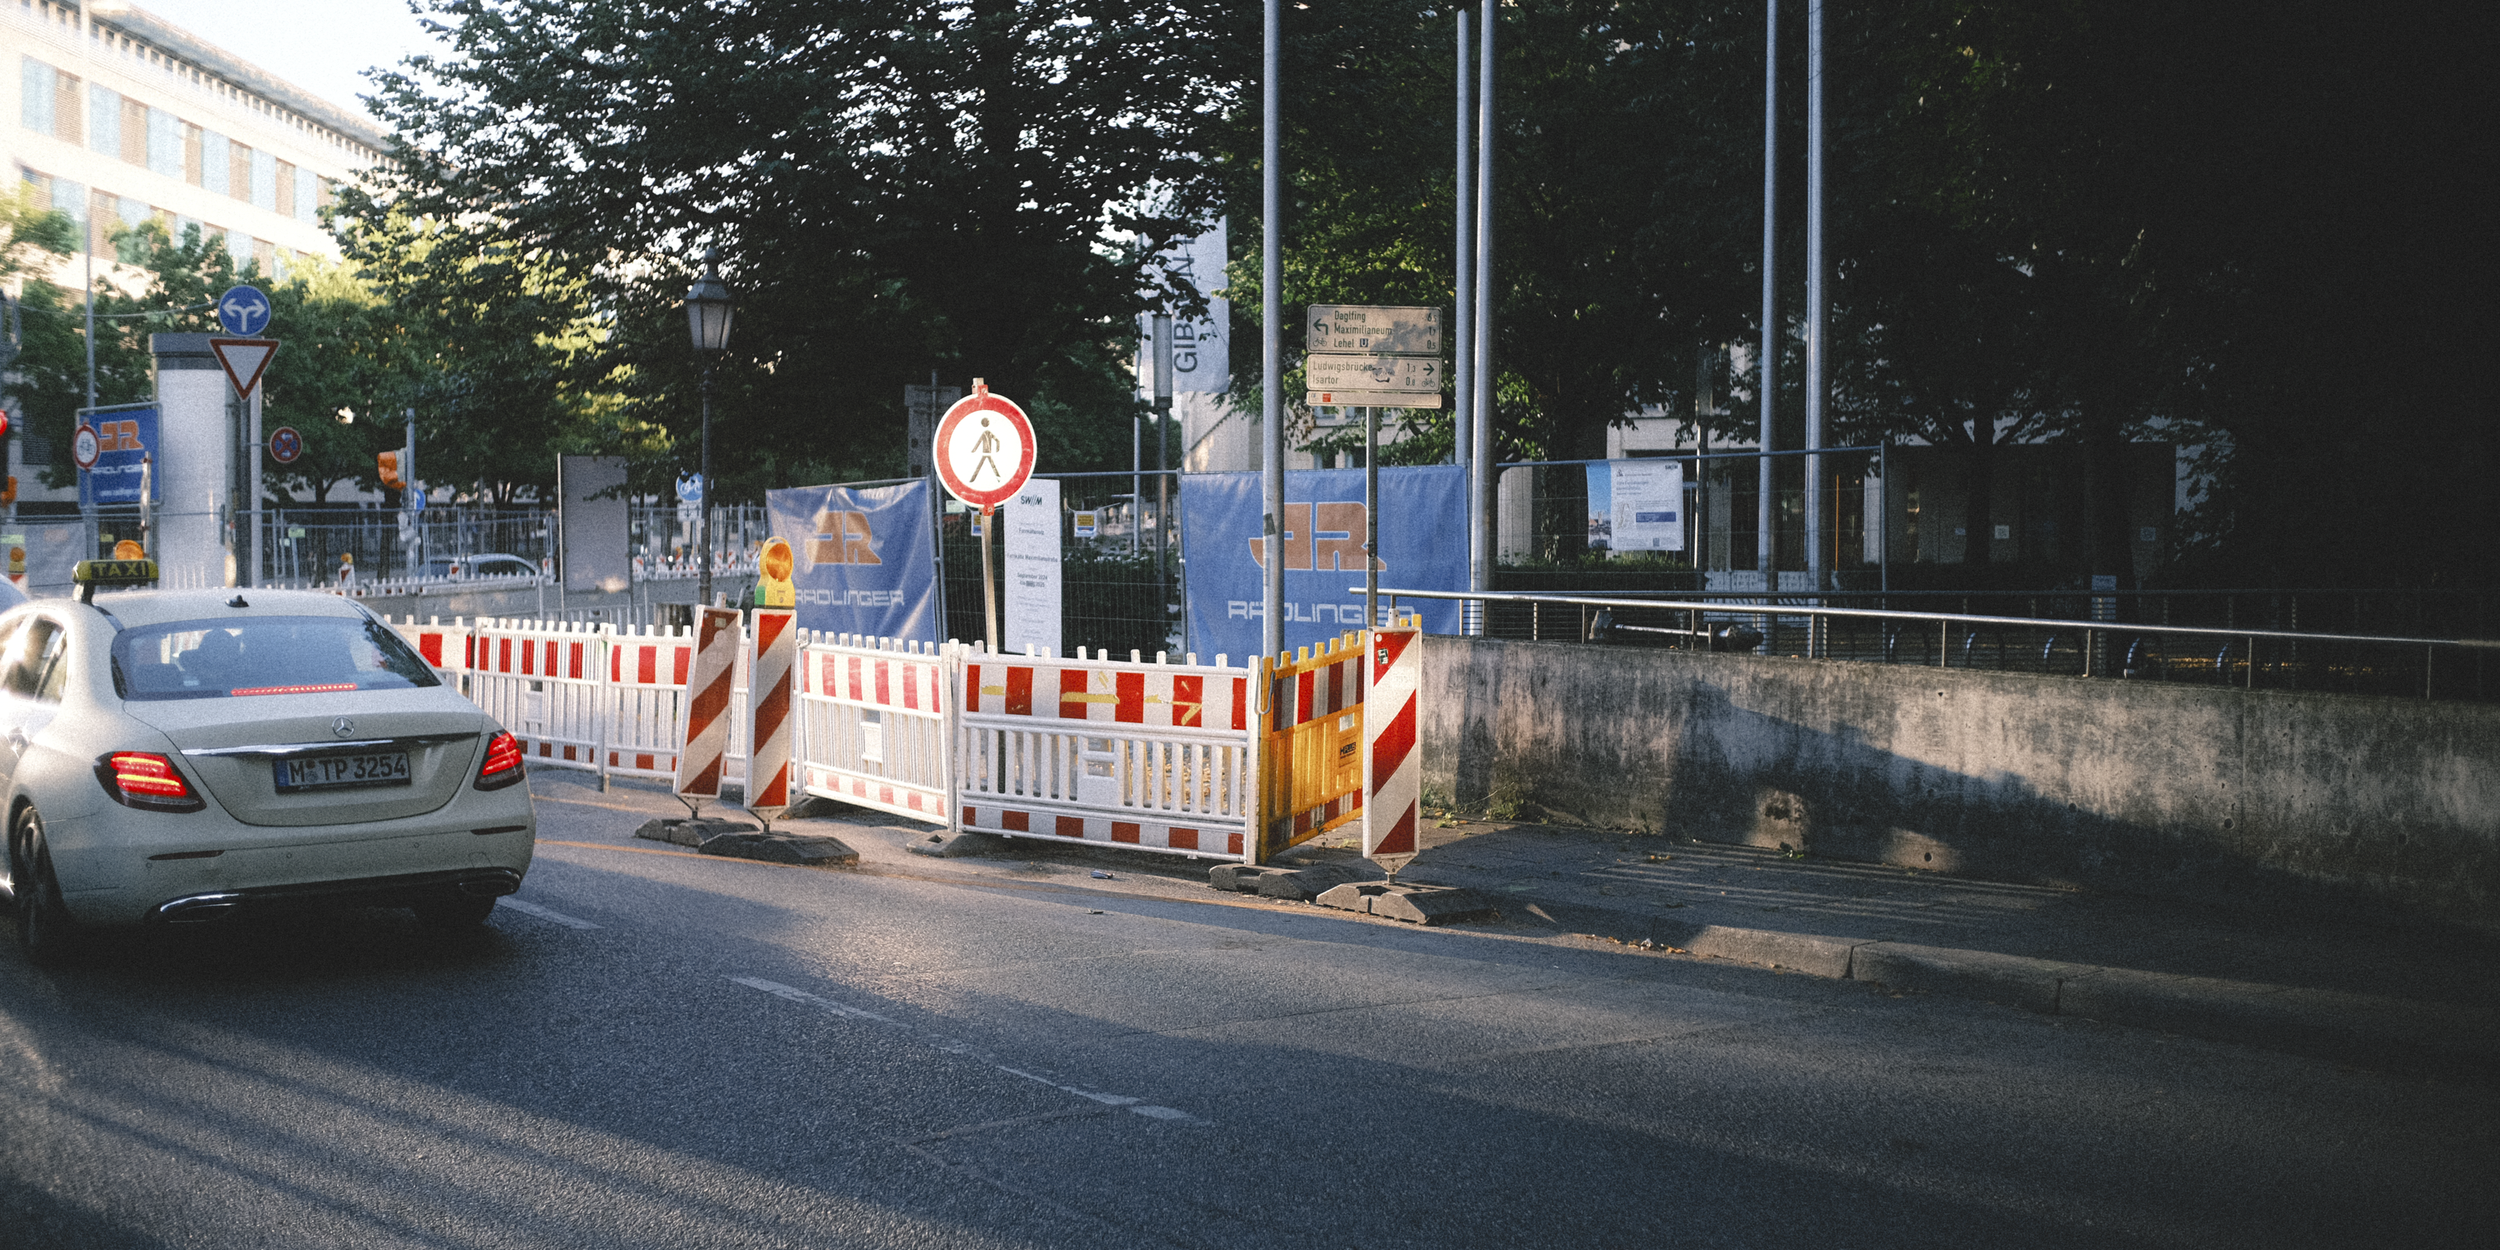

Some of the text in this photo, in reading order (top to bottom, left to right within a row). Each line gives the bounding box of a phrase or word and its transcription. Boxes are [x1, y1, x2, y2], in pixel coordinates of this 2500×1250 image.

[1173, 257, 1199, 373] GIBN
[1334, 310, 1366, 323] Daglfing
[1334, 323, 1392, 335] Maximilianeum
[1333, 339, 1355, 348] Lehel
[1313, 361, 1373, 373] Ludwigsbrücke
[1313, 375, 1339, 385] Isartor
[94, 562, 147, 577] TAXI
[289, 755, 407, 783] M TP 3254
